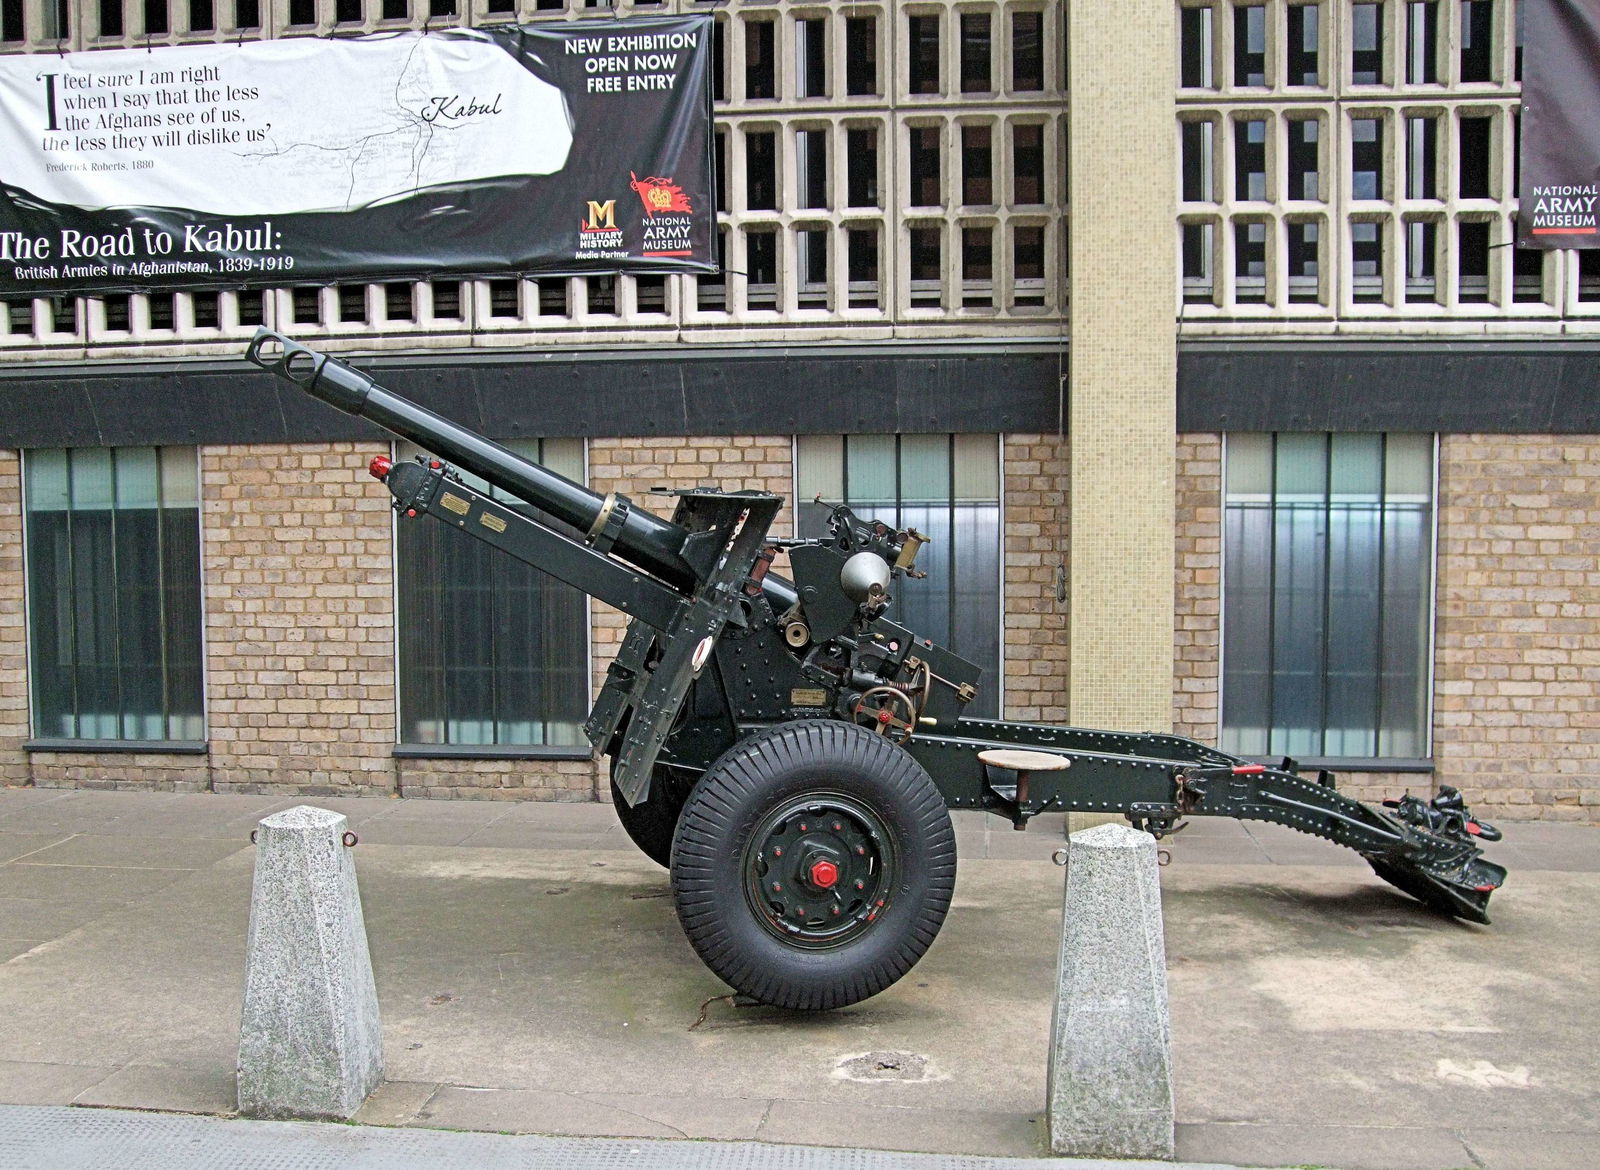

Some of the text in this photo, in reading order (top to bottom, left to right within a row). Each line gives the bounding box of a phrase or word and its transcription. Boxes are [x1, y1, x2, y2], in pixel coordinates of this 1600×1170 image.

[564, 32, 697, 55] NEW EXHIBITION
[584, 53, 678, 73] OPEN NOW
[63, 73, 92, 90] feel
[97, 75, 134, 88] sure
[138, 70, 145, 85] I
[150, 72, 175, 85] am
[180, 65, 221, 84] right
[587, 73, 677, 93] FREE ENTRY
[63, 85, 259, 110] when I say that the less
[421, 93, 502, 122] Kabul
[65, 107, 246, 133] the Afghans see of us,
[42, 136, 70, 151] the
[75, 135, 107, 151] less
[112, 133, 148, 151] they
[152, 130, 181, 148] will
[186, 128, 241, 146] dislike
[90, 160, 129, 172] Roberts,
[131, 159, 155, 171] 1880
[1533, 185, 1599, 196] NATIONAL
[586, 199, 617, 230] M
[1533, 196, 1598, 213] ARMY
[642, 217, 691, 226] NATIONAL
[1532, 214, 1596, 227] MUSEUM
[0, 221, 283, 261] The Road to Kabul:
[580, 231, 623, 241] MILITARY
[643, 226, 691, 239] ARMY
[580, 239, 623, 249] HISTORY
[642, 240, 692, 250] MUSEUM
[575, 250, 630, 259] Media Partner
[15, 256, 295, 280] British Armies in Afghanistan, 1839-1919
